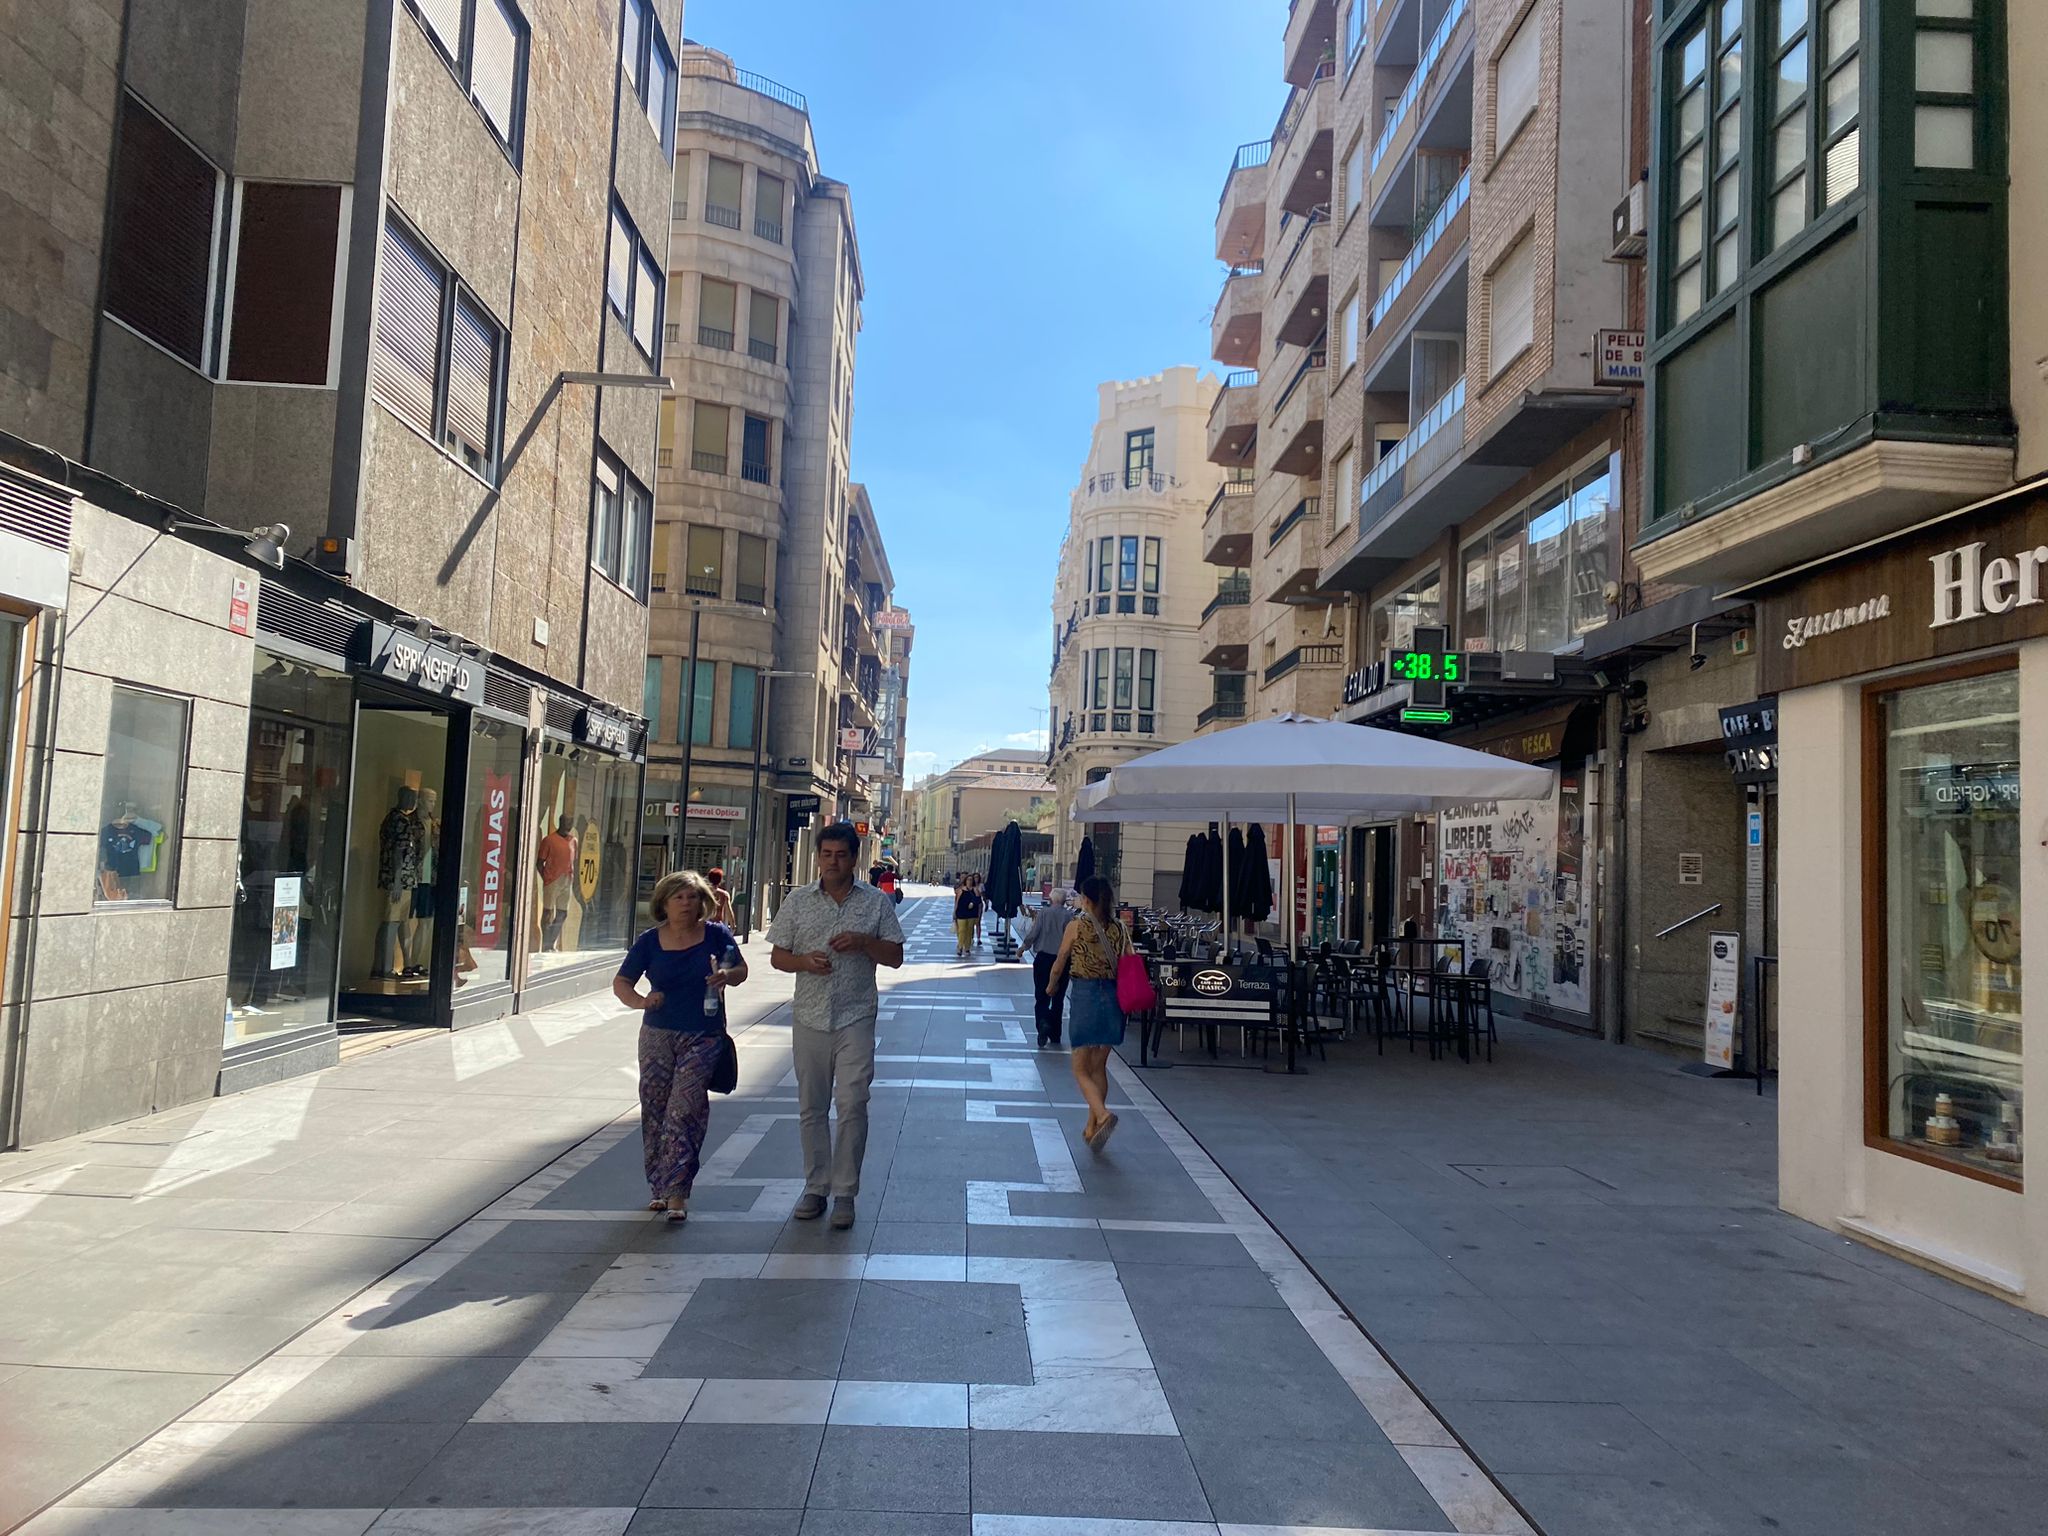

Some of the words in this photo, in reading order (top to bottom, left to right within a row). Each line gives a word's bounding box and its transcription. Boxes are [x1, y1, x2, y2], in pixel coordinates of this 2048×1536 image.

[1605, 350, 1623, 361] DE
[1633, 350, 1645, 362] S
[1928, 541, 2048, 629] Her
[1782, 593, 1892, 650] Zarzamora
[395, 643, 470, 691] SPRINGFIELD
[1393, 652, 1458, 681] +38.5
[715, 808, 739, 817] Optica
[1445, 825, 1475, 850] LIBRE
[1476, 824, 1492, 849] DE
[481, 788, 505, 934] REBAJAS
[1237, 979, 1270, 990] Terraza
